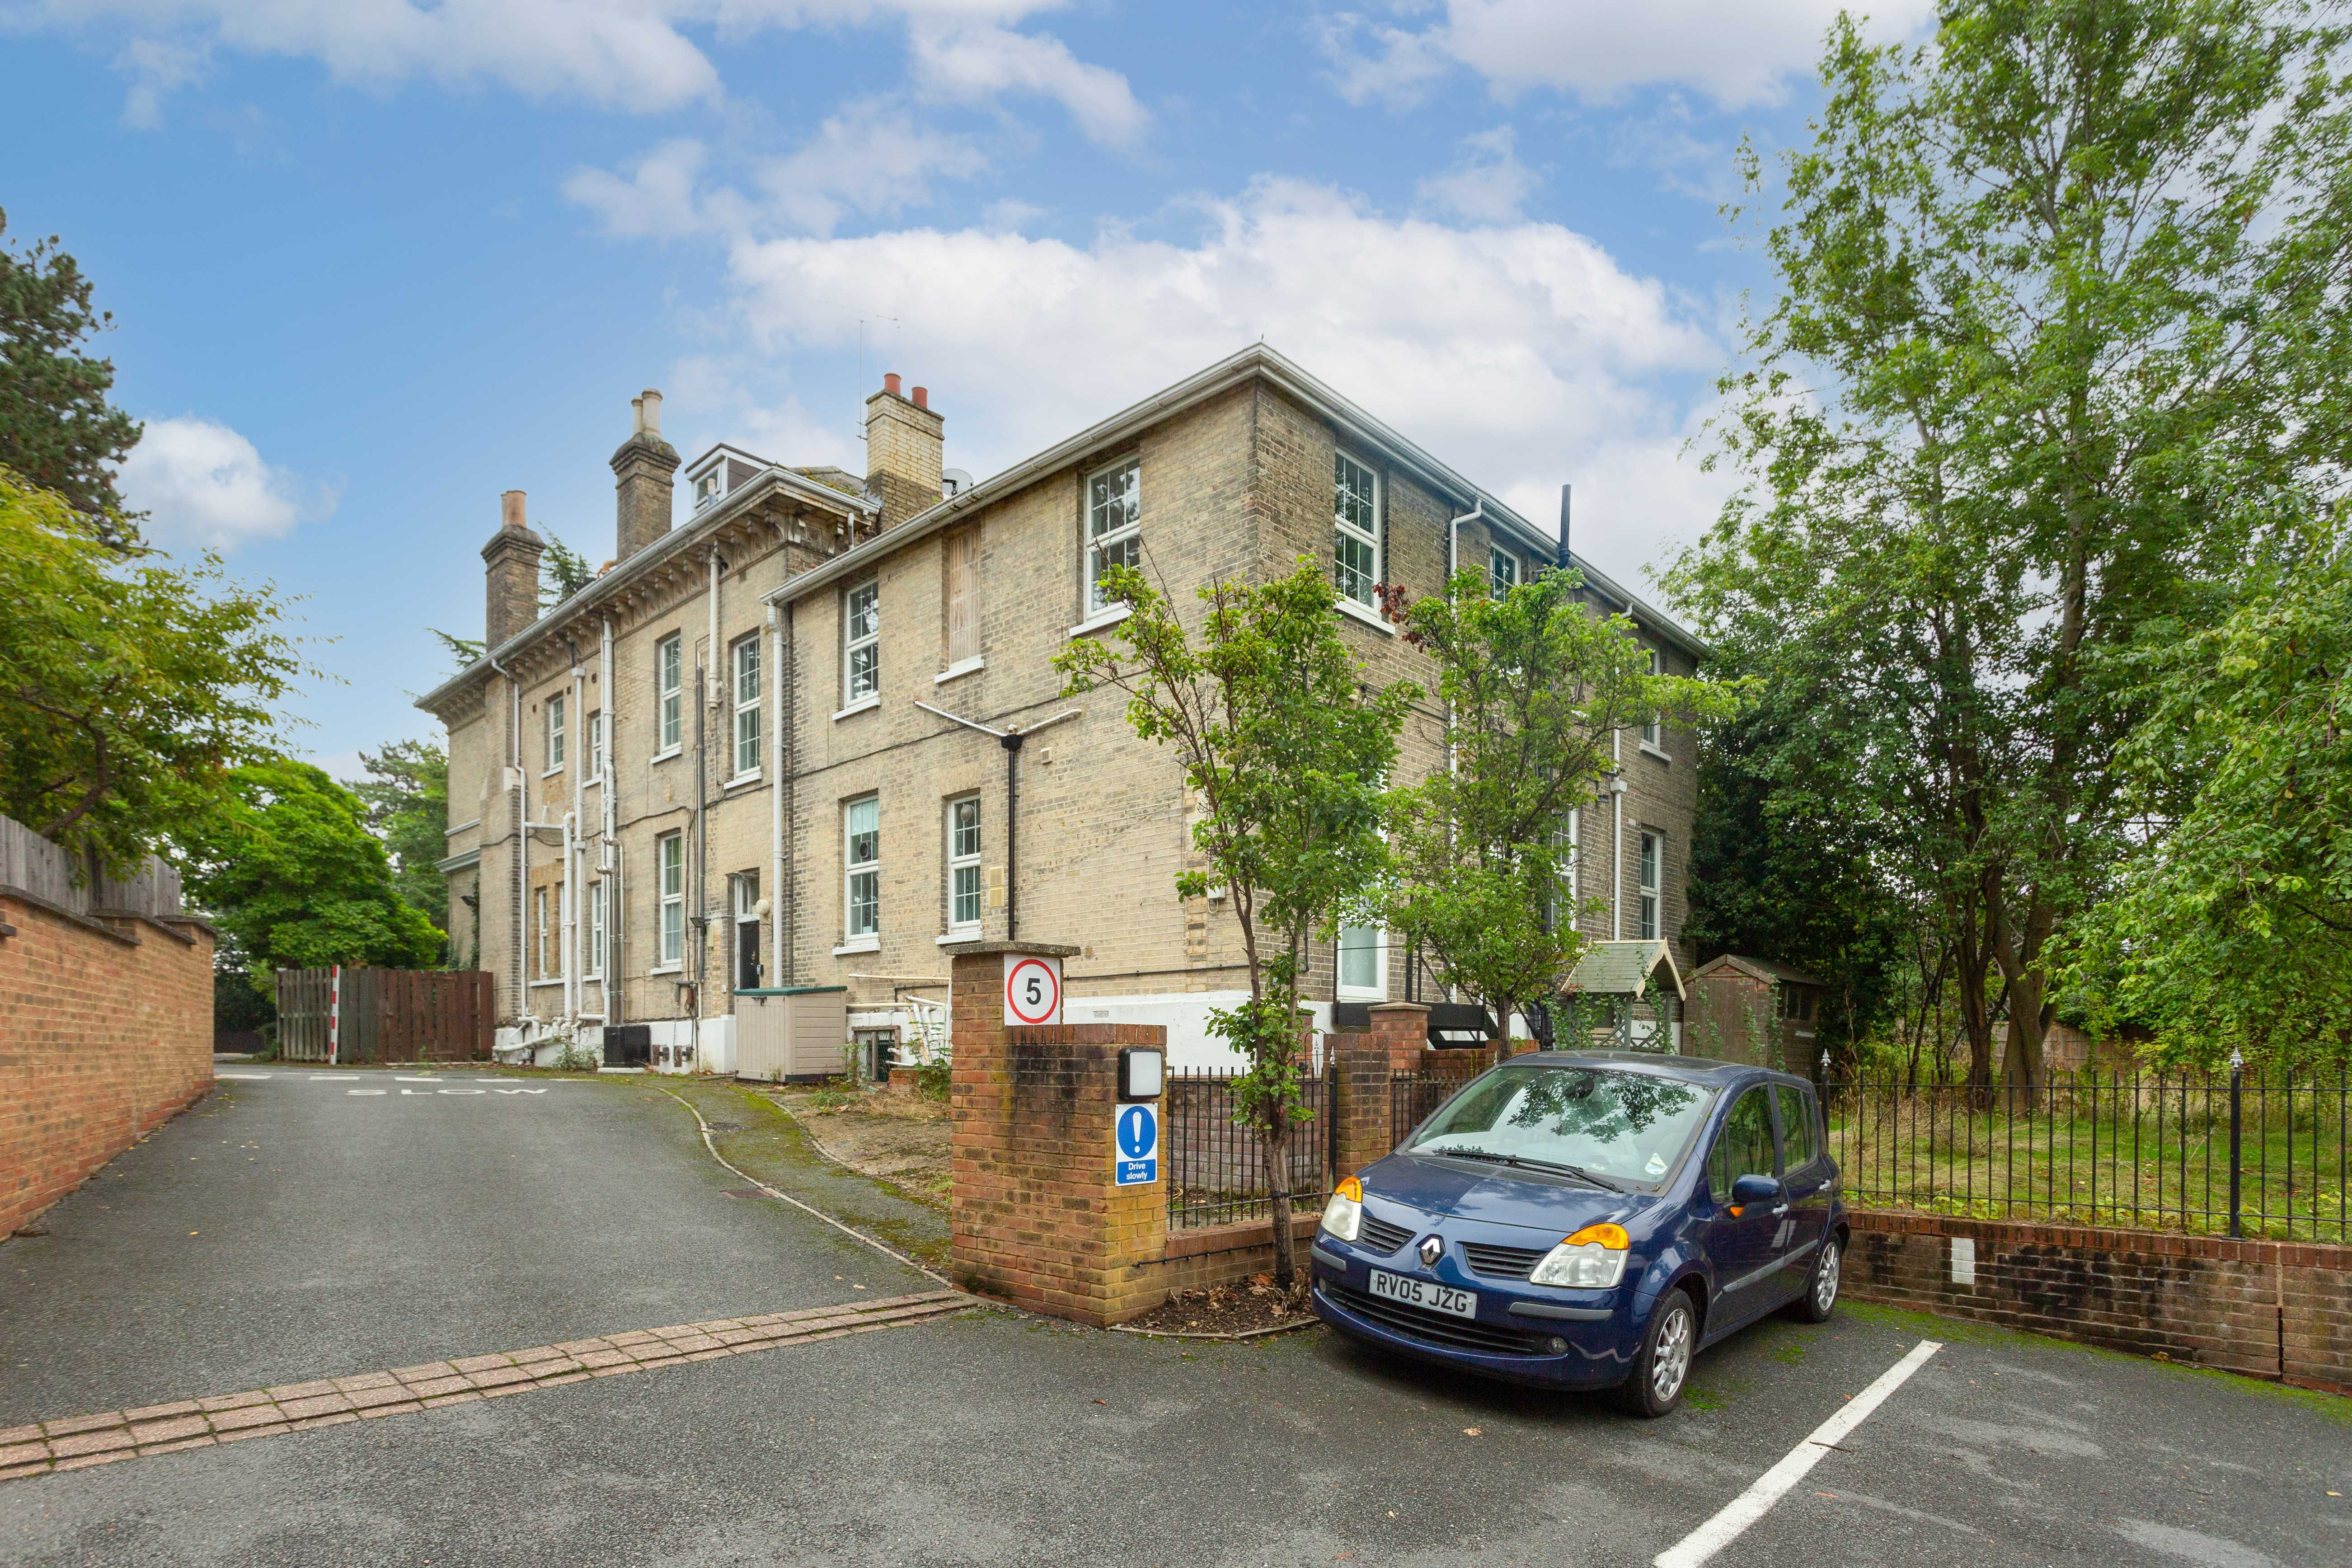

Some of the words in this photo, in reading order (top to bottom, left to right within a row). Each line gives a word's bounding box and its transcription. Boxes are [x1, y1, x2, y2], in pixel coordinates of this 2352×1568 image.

[1026, 977, 1041, 1005] 5
[1128, 1162, 1146, 1170] Drive
[1126, 1171, 1148, 1180] slowly
[1376, 1273, 1422, 1302] RV05
[1428, 1288, 1468, 1313] JZG
